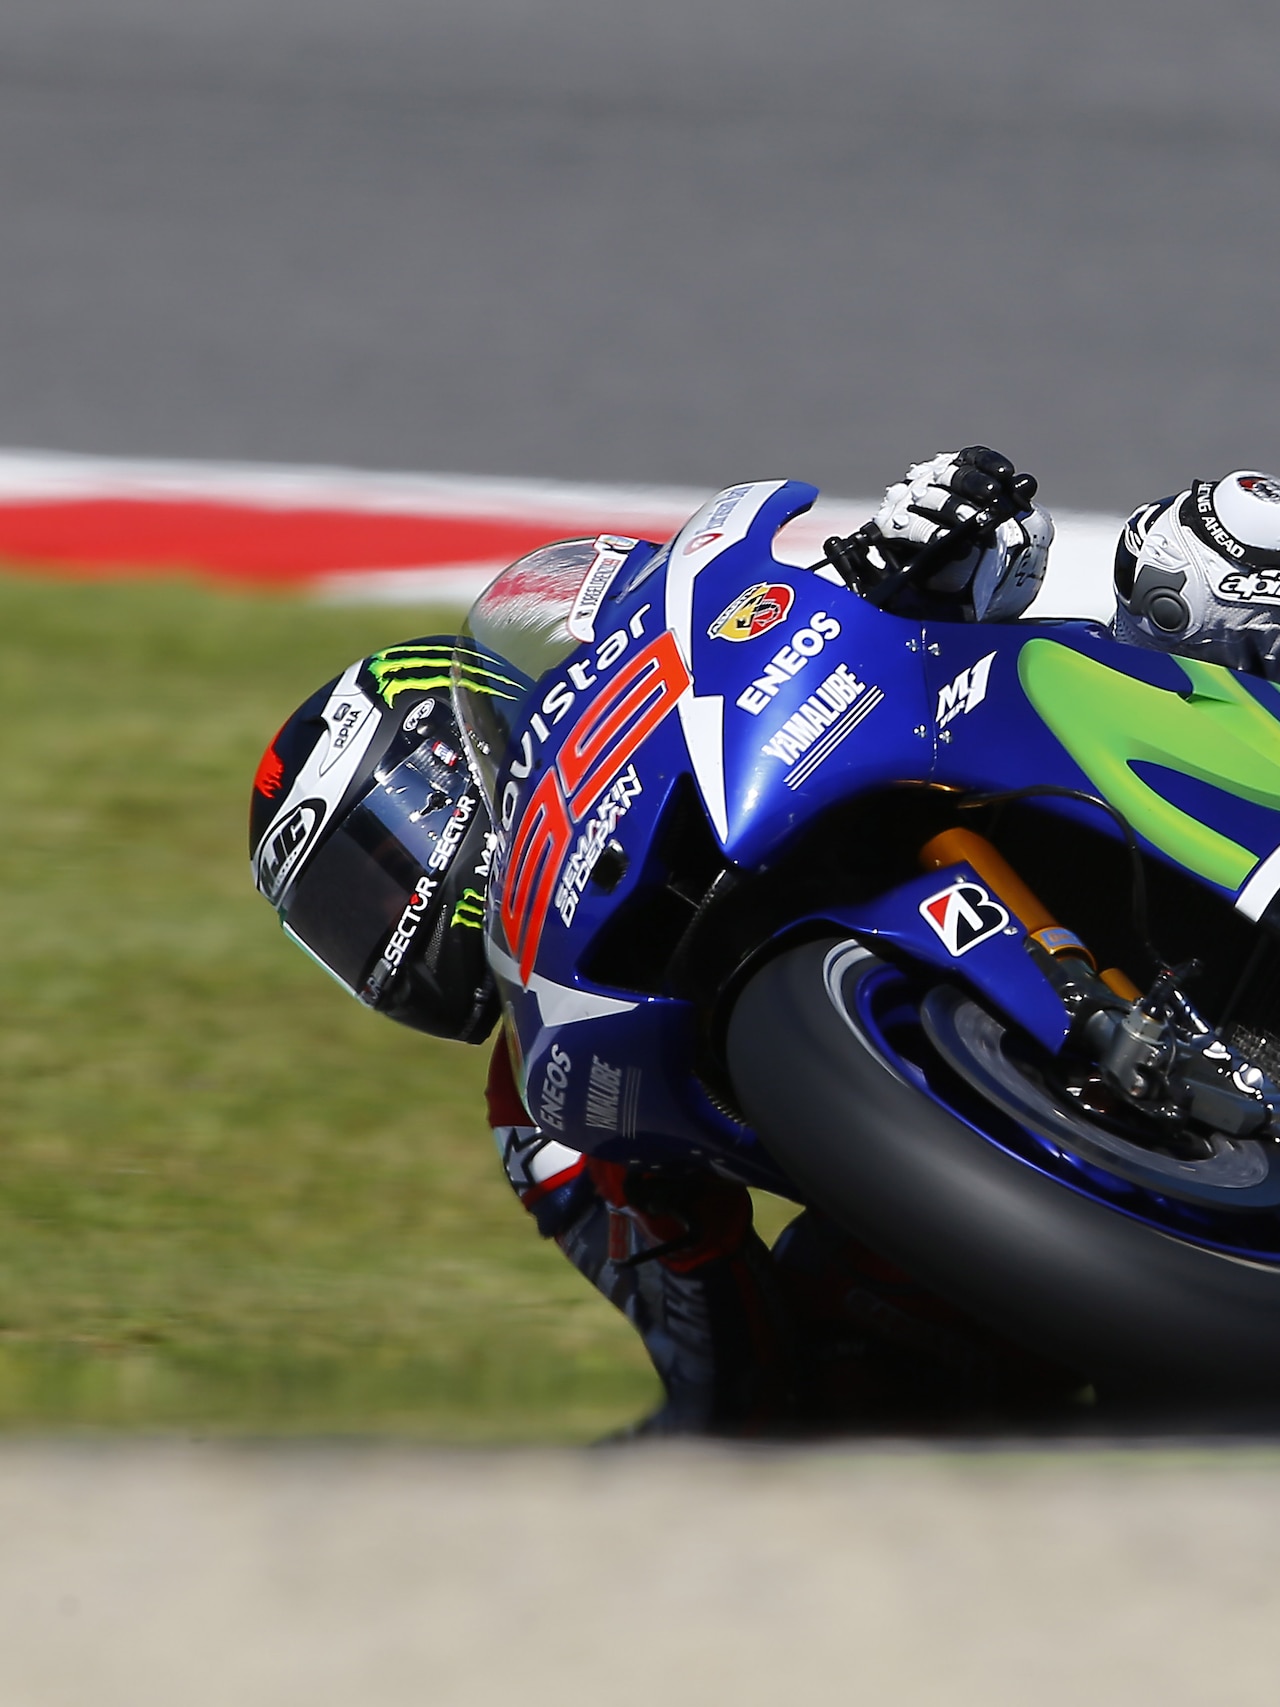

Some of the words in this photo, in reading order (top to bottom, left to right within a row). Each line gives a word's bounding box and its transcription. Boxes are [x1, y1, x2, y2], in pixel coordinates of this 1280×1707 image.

[1202, 517, 1245, 558] AHEAD
[735, 610, 842, 716] ENEOS
[333, 708, 361, 751] RPHA
[761, 663, 866, 766] YAMALUBE
[428, 795, 476, 871] SECTOR
[501, 629, 692, 990] 99
[383, 875, 438, 965] SECTOR
[540, 1043, 571, 1131] ENEOS
[585, 1053, 622, 1131] YAMALUBE
